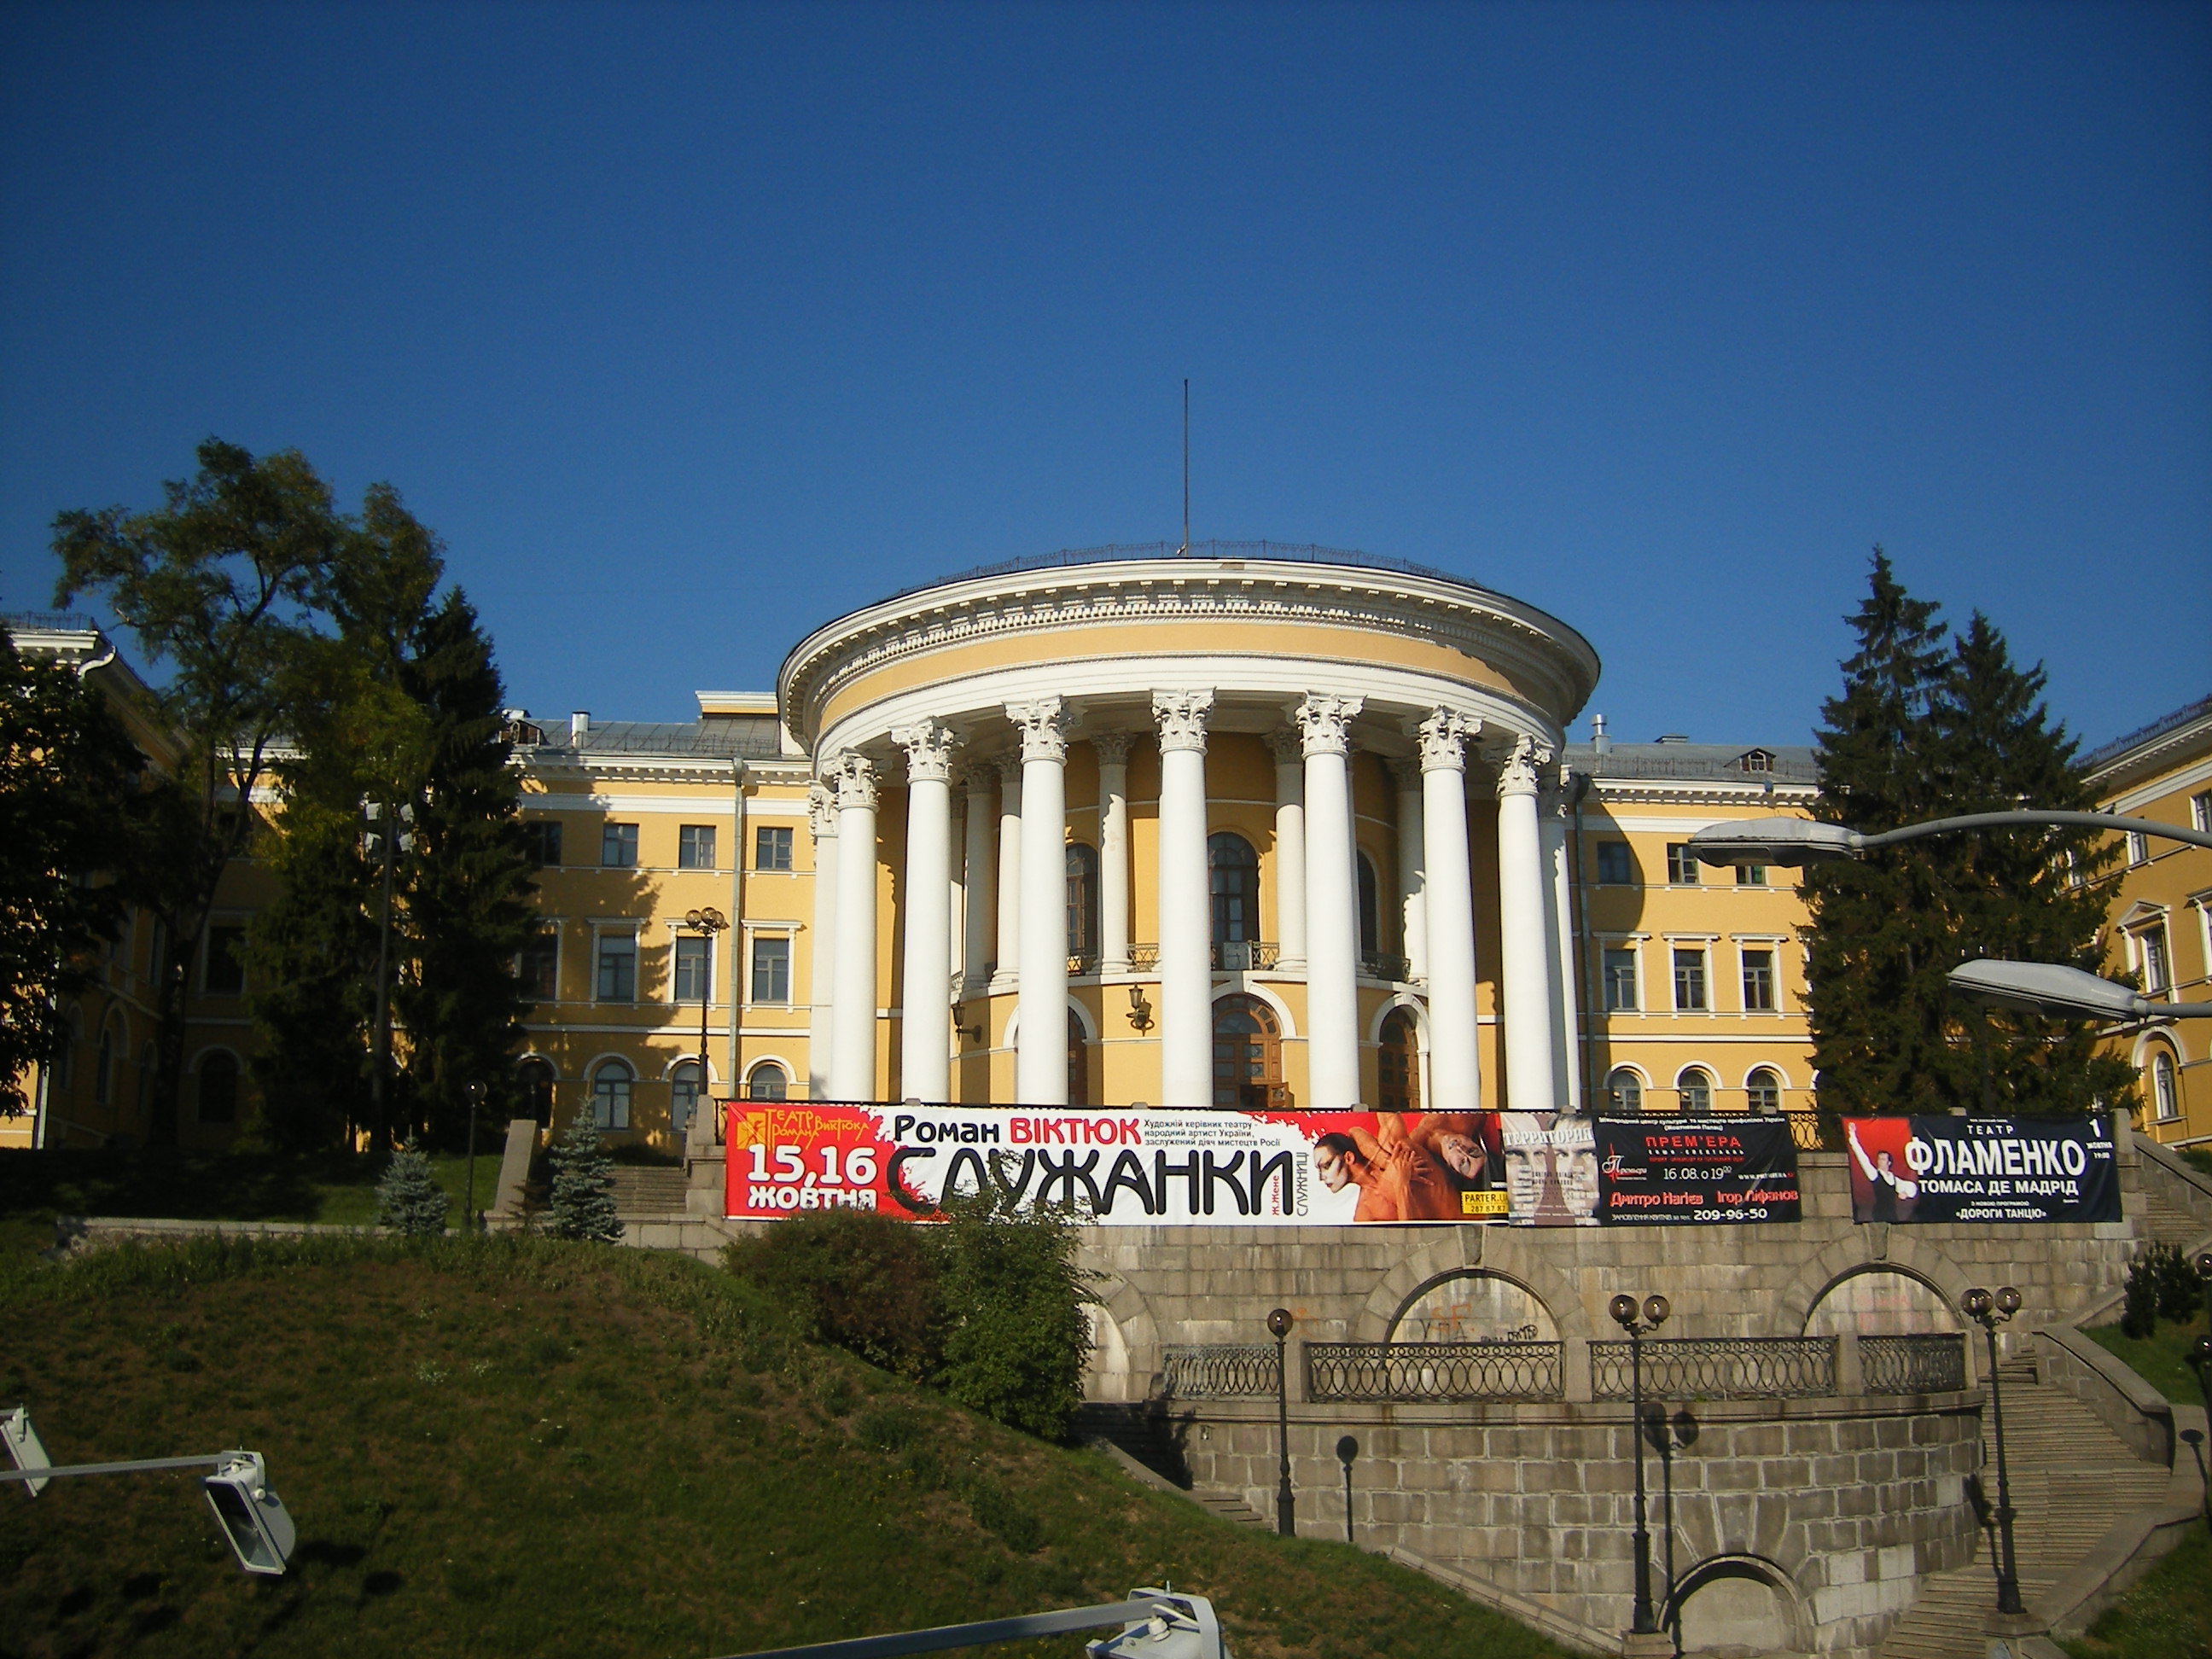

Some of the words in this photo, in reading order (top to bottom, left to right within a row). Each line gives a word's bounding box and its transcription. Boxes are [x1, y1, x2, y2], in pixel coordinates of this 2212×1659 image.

[895, 1115, 999, 1143] Роман
[1010, 1118, 1141, 1145] ВІКТЮК
[1144, 1120, 1183, 1128] Художній
[1185, 1121, 1222, 1129] керівник
[1966, 1125, 2014, 1135] ТЕАТР
[1188, 1130, 1217, 1138] артист
[1504, 1127, 1593, 1146] ТЕРРИТОРИЯ
[1905, 1136, 2086, 1177] ФЛАМЕНКО
[748, 1144, 877, 1187] 15,16
[887, 1148, 1294, 1215] СЛУЖАНКИ
[1918, 1179, 1985, 1194] ТОМАСА
[1988, 1180, 2011, 1196] ДЕ
[2015, 1180, 2079, 1196] МАДРІД
[1610, 1192, 1661, 1208] Дмитро
[1694, 1208, 1768, 1220] 209-96-50
